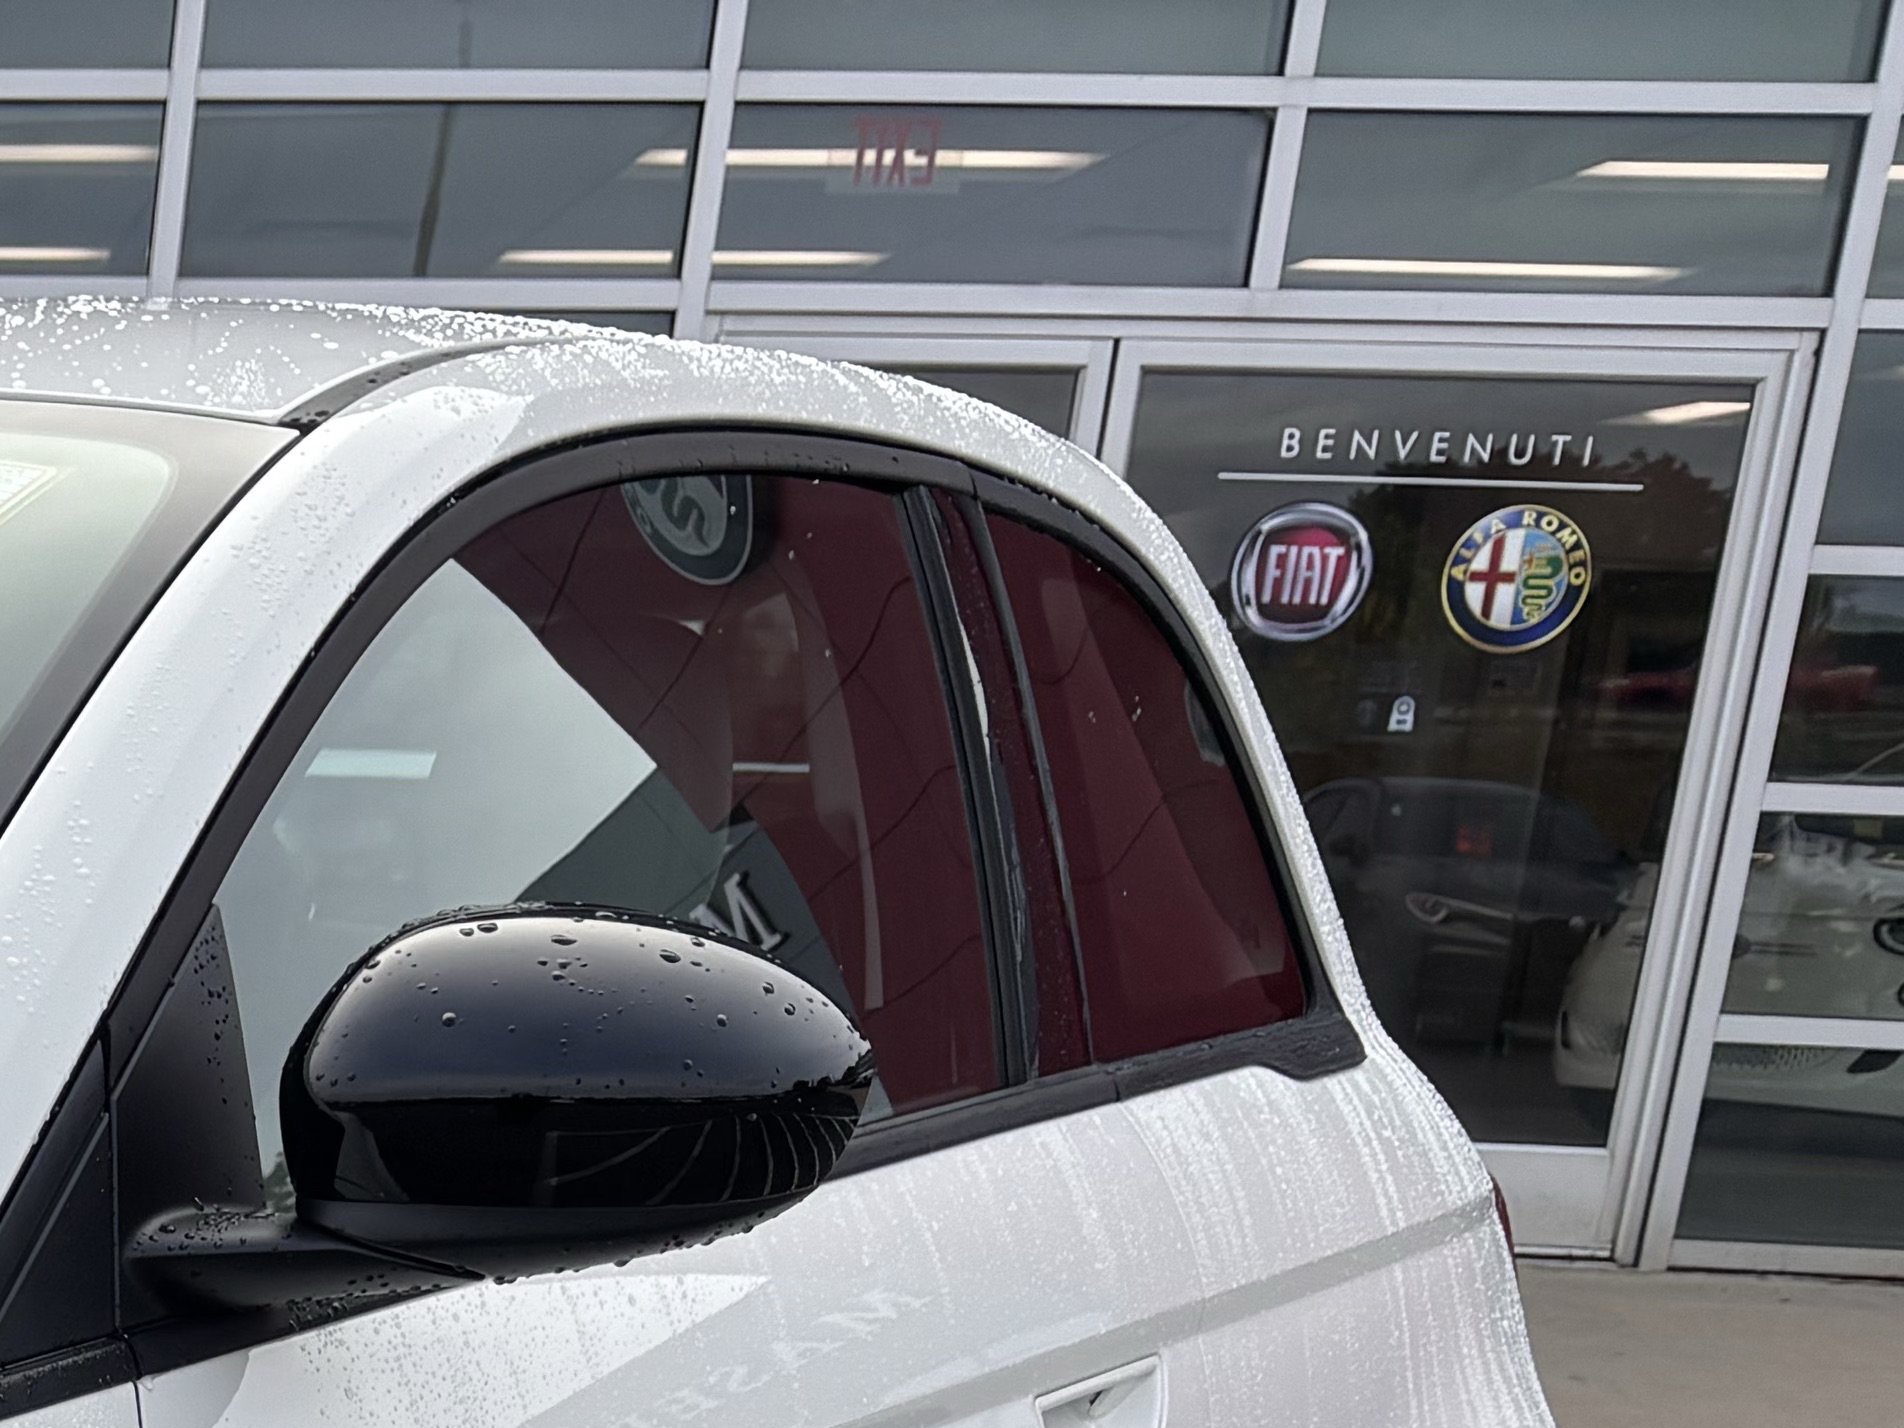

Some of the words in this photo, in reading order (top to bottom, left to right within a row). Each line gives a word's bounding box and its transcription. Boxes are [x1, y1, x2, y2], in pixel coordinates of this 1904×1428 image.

[1280, 427, 1595, 467] BENVENUTI
[1260, 543, 1347, 606] FIAT
[1450, 516, 1505, 581] ALFA
[1521, 509, 1587, 588] ROMEO
